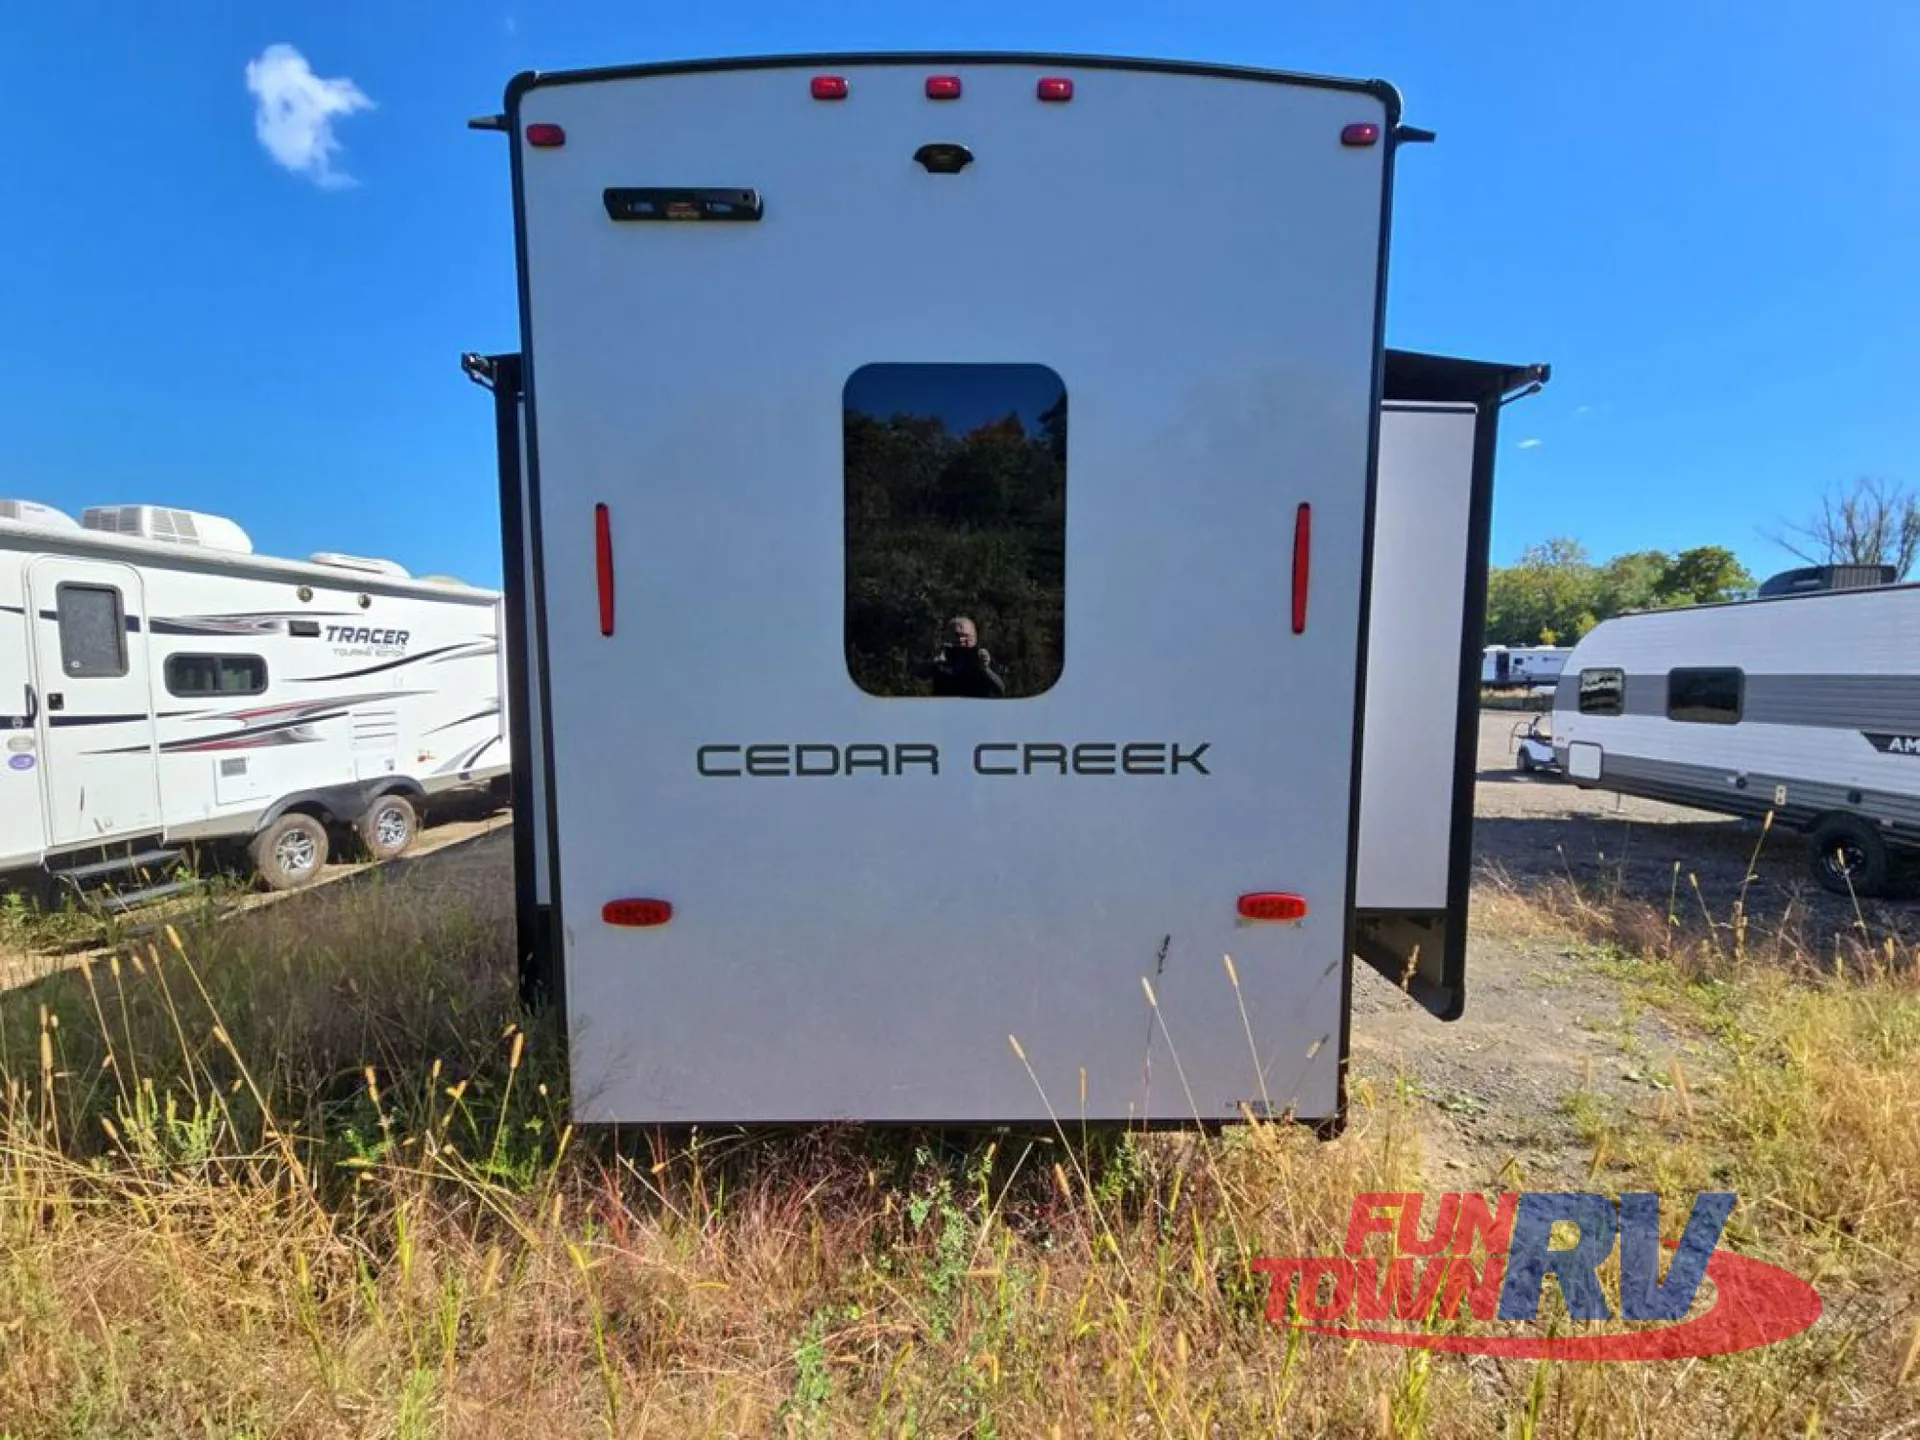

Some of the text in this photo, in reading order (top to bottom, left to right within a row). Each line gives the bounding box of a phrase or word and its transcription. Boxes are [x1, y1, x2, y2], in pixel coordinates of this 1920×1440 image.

[326, 625, 410, 645] TRACER
[696, 742, 1212, 777] CEDAR CREEK
